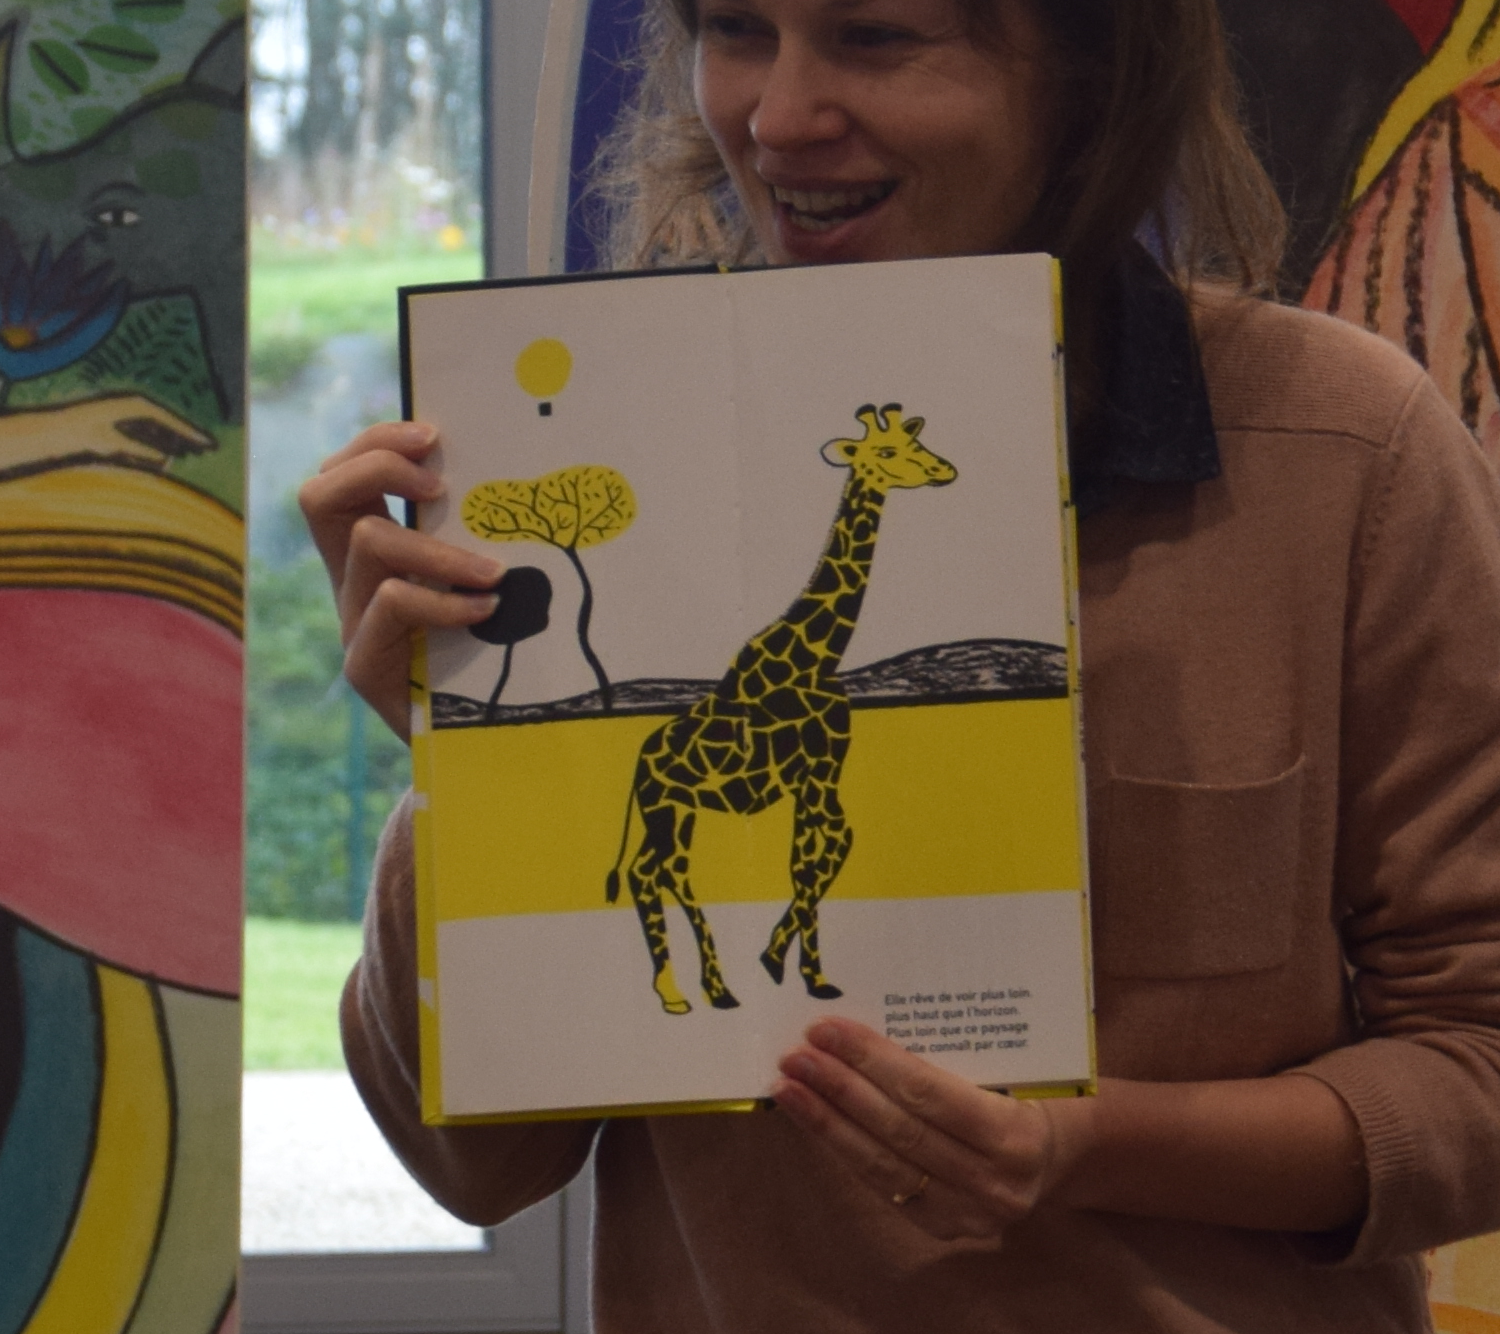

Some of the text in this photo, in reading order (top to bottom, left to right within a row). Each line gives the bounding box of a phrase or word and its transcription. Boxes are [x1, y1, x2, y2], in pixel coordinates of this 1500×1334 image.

[885, 993, 906, 1006] Elle
[938, 992, 952, 1003] de
[955, 990, 977, 1001] voir
[981, 989, 1005, 1002] plus
[885, 1011, 910, 1023] plus
[913, 1010, 939, 1020] haut
[942, 1010, 964, 1021] que
[940, 1026, 961, 1037] que
[964, 1025, 978, 1034] ce
[981, 1023, 1029, 1035] paysage
[974, 1041, 994, 1052] par
